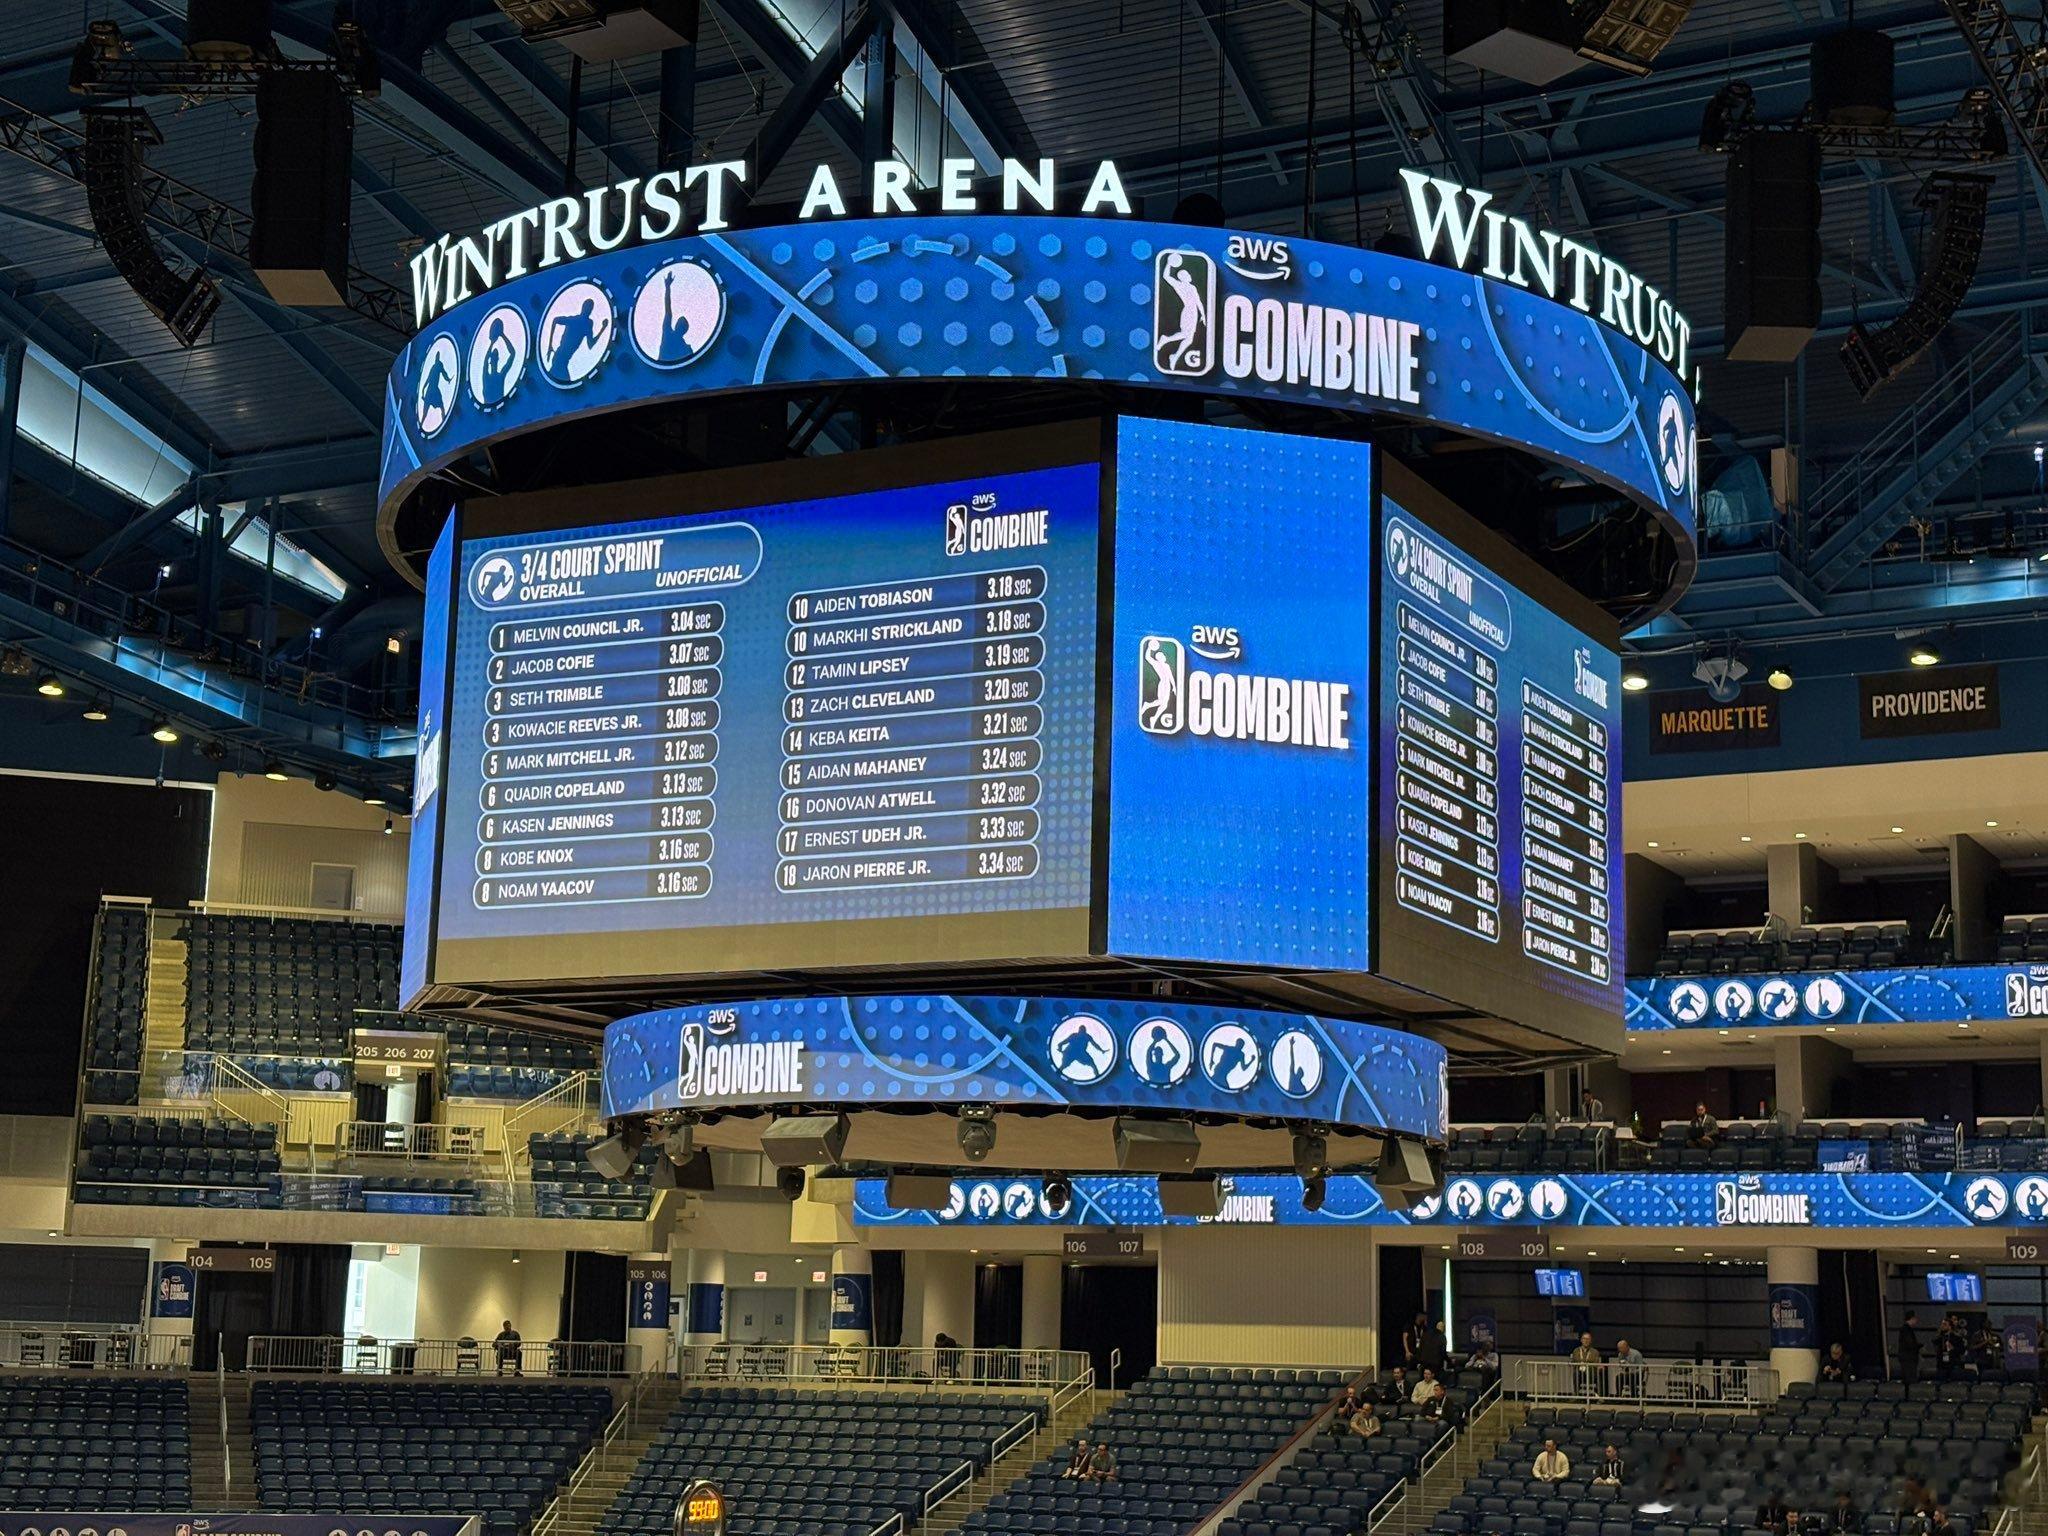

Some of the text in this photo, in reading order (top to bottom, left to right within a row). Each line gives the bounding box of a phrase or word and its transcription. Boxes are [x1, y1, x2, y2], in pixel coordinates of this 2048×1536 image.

[410, 158, 1132, 329] WINTRUST ARENA
[1228, 235, 1288, 264] aws
[1399, 168, 1691, 381] WINTRUST
[1222, 294, 1420, 404] COMBINE
[972, 492, 995, 505] aws
[970, 510, 1049, 553] COMBINE
[521, 539, 663, 585] 3/4 COURT SPRINT
[656, 565, 743, 588] UNOFFICIAL
[1410, 537, 1472, 605] 3/4 COURT SPRINT
[520, 581, 585, 601] OVERALL
[795, 598, 808, 620] 10
[814, 596, 856, 614] AIDEN
[859, 588, 932, 609] TOBIASON
[988, 575, 1012, 598] 3.18
[1411, 572, 1440, 604] OVERALL
[499, 629, 504, 648] 1
[514, 626, 560, 643] MELVIN
[563, 621, 620, 638] COUNCIL
[623, 619, 644, 633] JR.
[671, 610, 693, 632] 3.04
[794, 631, 807, 653] 10
[814, 628, 868, 647] MARKHI
[871, 618, 962, 640] STRICKLAND
[987, 610, 1011, 632] 3.18
[1192, 625, 1239, 646] aws
[1470, 610, 1504, 645] UNOFFICIAL
[496, 660, 503, 680] 2
[512, 658, 553, 675] JACOB
[557, 654, 595, 670] COFIE
[669, 643, 692, 664] 3.07
[792, 664, 805, 686] 12
[812, 662, 856, 679] TAMIN
[860, 657, 909, 675] LIPSEY
[986, 644, 1010, 667] 3.19
[1408, 650, 1446, 683] JACOB COFIE
[493, 691, 502, 711] 3
[510, 691, 543, 706] SETH
[546, 686, 603, 703] TRIMBLE
[668, 675, 691, 697] 3.08
[791, 697, 804, 719] 13
[811, 696, 848, 713] ZACH
[852, 689, 935, 709] CLEVELAND
[985, 678, 1009, 701] 3.20
[1408, 681, 1424, 702] SETH
[1872, 686, 1986, 718] PROVIDENCE
[492, 723, 500, 743] 3
[509, 721, 566, 738] KOWACIE
[569, 716, 618, 733] REEVES
[621, 715, 642, 729] JR.
[666, 707, 689, 729] 3.08
[1188, 670, 1349, 750] COMBINE
[1661, 704, 1768, 735] MARQUETTE
[789, 730, 802, 751] 14
[809, 730, 845, 746] KEBA
[849, 726, 889, 743] KEITA
[984, 713, 1007, 735] 3.21
[490, 755, 498, 775] 5
[506, 754, 544, 770] MARK
[547, 749, 611, 767] MITCHELL
[614, 748, 635, 761] JR.
[665, 740, 688, 761] 3.12
[788, 764, 801, 785] 15
[807, 763, 850, 780] AIDAN
[854, 757, 927, 776] MAHANEY
[982, 747, 1007, 770] 3.24
[488, 786, 496, 807] 6
[505, 786, 552, 803] QUADIR
[555, 780, 625, 798] COPELAND
[663, 773, 686, 794] 3.13
[786, 797, 799, 819] 16
[806, 795, 875, 813] DONOVAN
[878, 791, 936, 808] ATWELL
[981, 782, 1006, 804] 3.32
[486, 818, 494, 839] 6
[502, 818, 545, 834] KASEN
[547, 813, 613, 831] JENNINGS
[661, 806, 684, 827] 3.13
[784, 831, 798, 852] 17
[805, 830, 859, 847] ERNEST
[862, 827, 900, 843] UDEH
[904, 826, 927, 840] JR.
[980, 816, 1005, 839] 3.33
[484, 850, 492, 871] 8
[500, 851, 534, 866] KOBE
[537, 848, 573, 864] KNOX
[659, 838, 682, 860] 3.16
[783, 864, 796, 886] 18
[803, 865, 850, 881] JARON
[854, 861, 905, 878] PIERRE
[908, 860, 931, 875] JR.
[979, 852, 1004, 874] 3.34
[481, 882, 490, 903] 8
[499, 883, 538, 898] NOAM
[541, 879, 594, 896] YAACOV
[657, 872, 681, 893] 3.16
[708, 1008, 735, 1025] aws
[356, 1047, 434, 1060] 205 206 207
[703, 1041, 804, 1095] COMBINE
[1738, 1175, 1760, 1184] aws
[1215, 1196, 1274, 1222] OMBINE
[1738, 1194, 1809, 1223] COMBINE
[190, 1255, 272, 1269] 104 105
[1066, 1241, 1139, 1252] 106 107
[1461, 1243, 1544, 1256] 108 109
[2010, 1245, 2037, 1258] 109
[630, 1270, 666, 1279] 105 106
